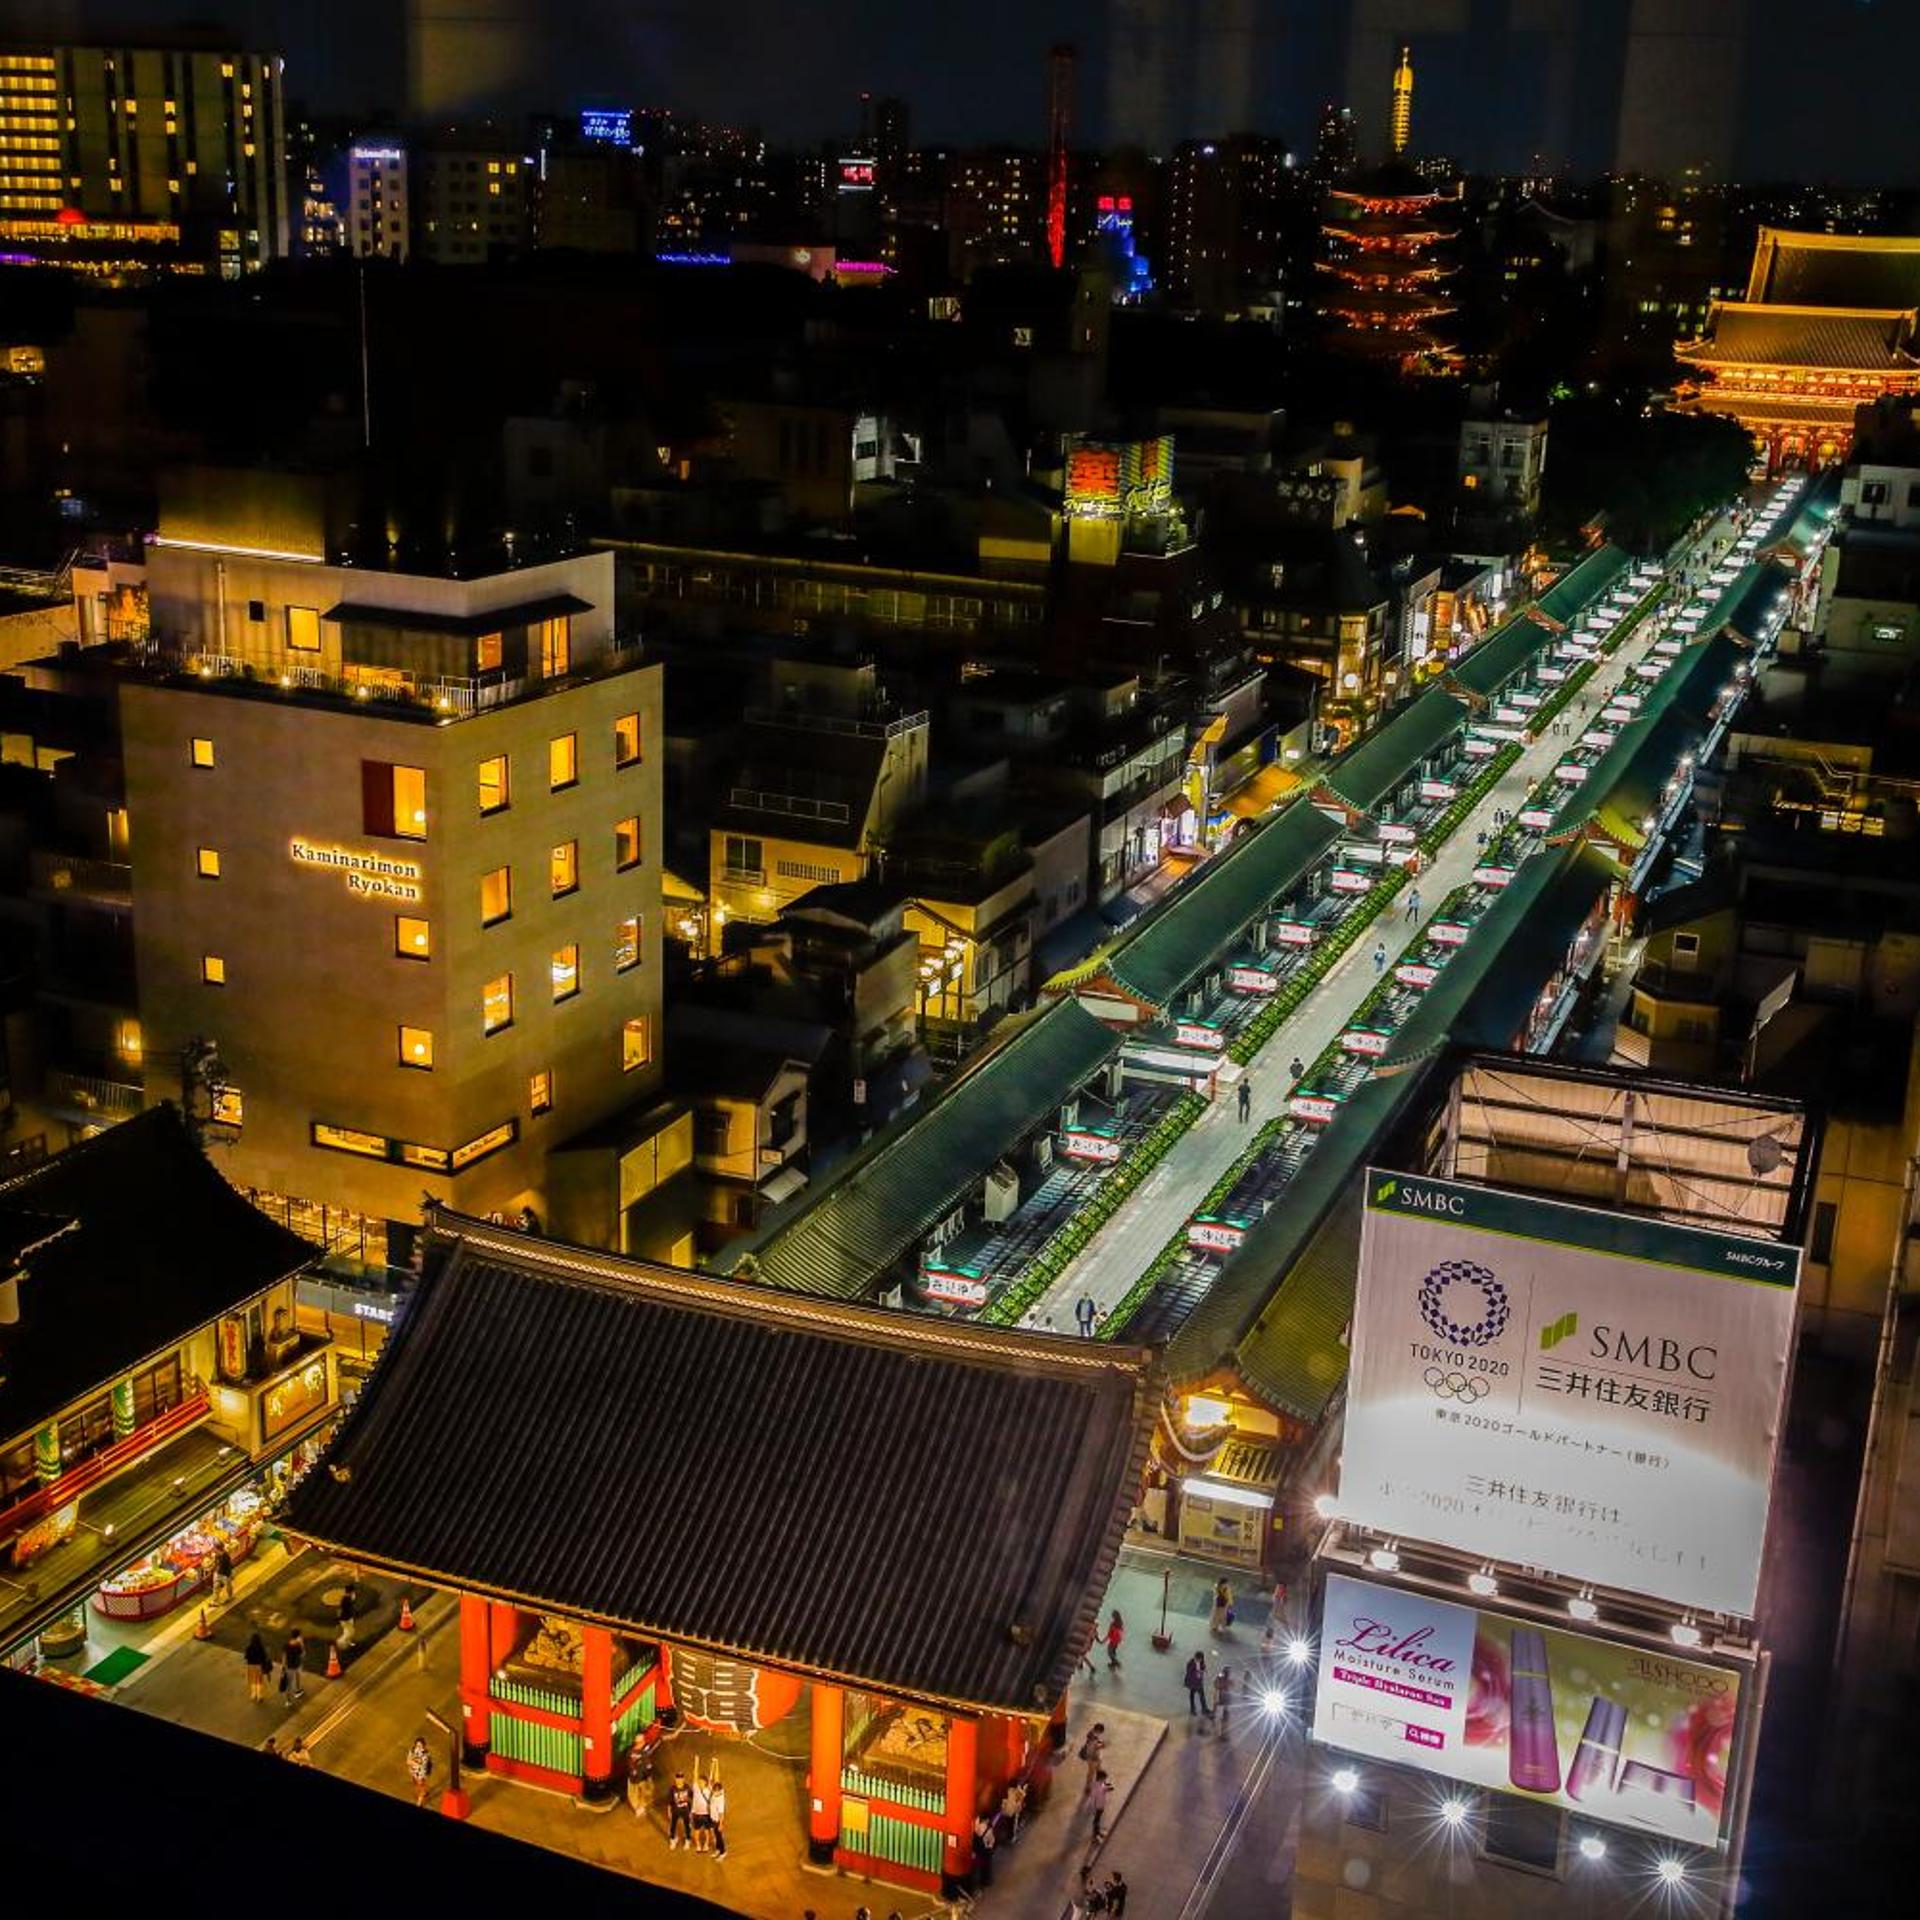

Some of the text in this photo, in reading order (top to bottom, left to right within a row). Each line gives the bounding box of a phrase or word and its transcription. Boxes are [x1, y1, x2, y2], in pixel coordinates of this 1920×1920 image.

[292, 844, 416, 875] Kaminarimon
[349, 874, 416, 898] Ryokan
[1401, 1187, 1464, 1215] SMBC
[1410, 1343, 1509, 1377] TOKYO 2020
[1590, 1325, 1718, 1380] SMBC
[1536, 1366, 1710, 1423] 三井住友銀行
[1335, 1617, 1456, 1673] Lilica
[1334, 1649, 1455, 1690] Moisture Serum
